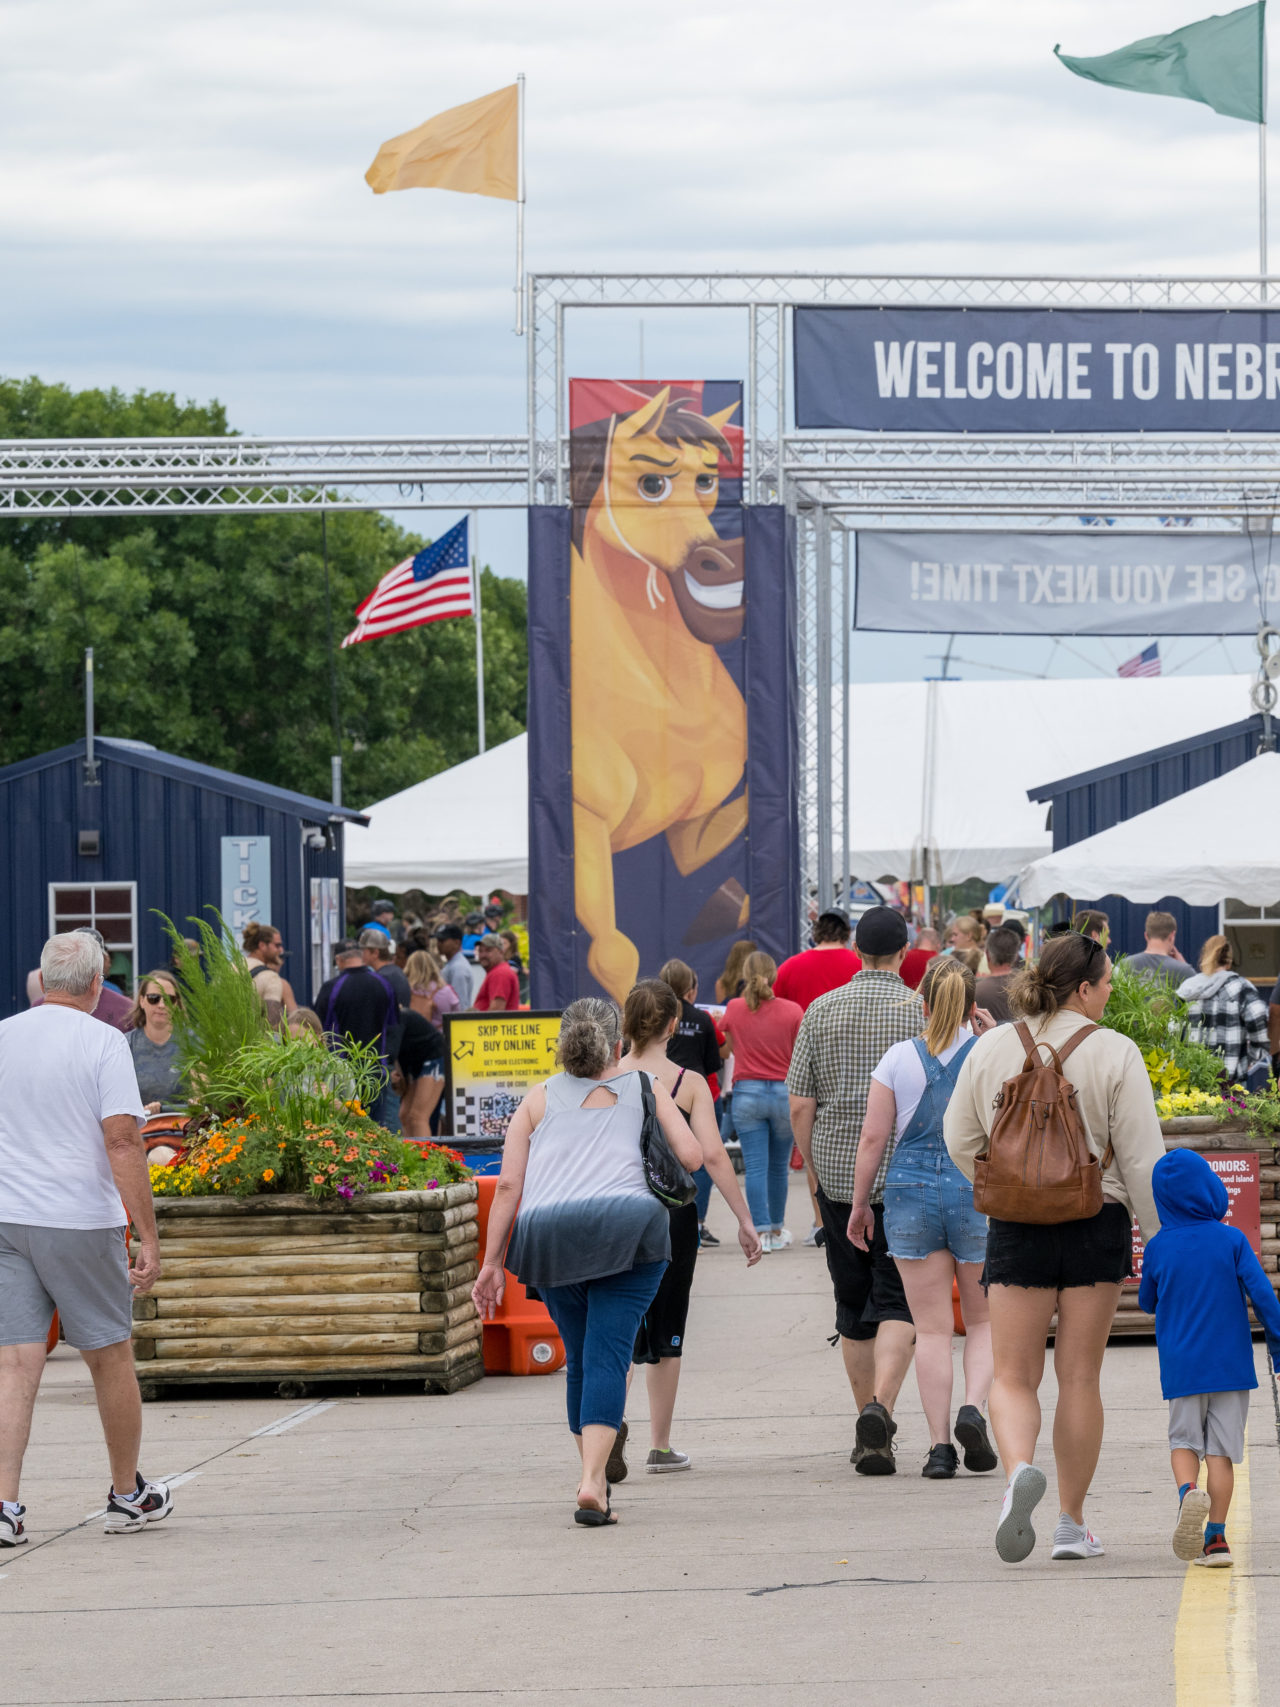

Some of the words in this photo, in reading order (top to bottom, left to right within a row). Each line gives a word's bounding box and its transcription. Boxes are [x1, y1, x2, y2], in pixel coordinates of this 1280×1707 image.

[873, 340, 1093, 400] WELCOME
[1104, 342, 1160, 400] TO
[478, 1025, 498, 1037] SKIP
[501, 1024, 518, 1036] THE
[521, 1024, 540, 1035] LINE
[483, 1040, 501, 1051] BUY
[503, 1039, 536, 1051] ONLINE
